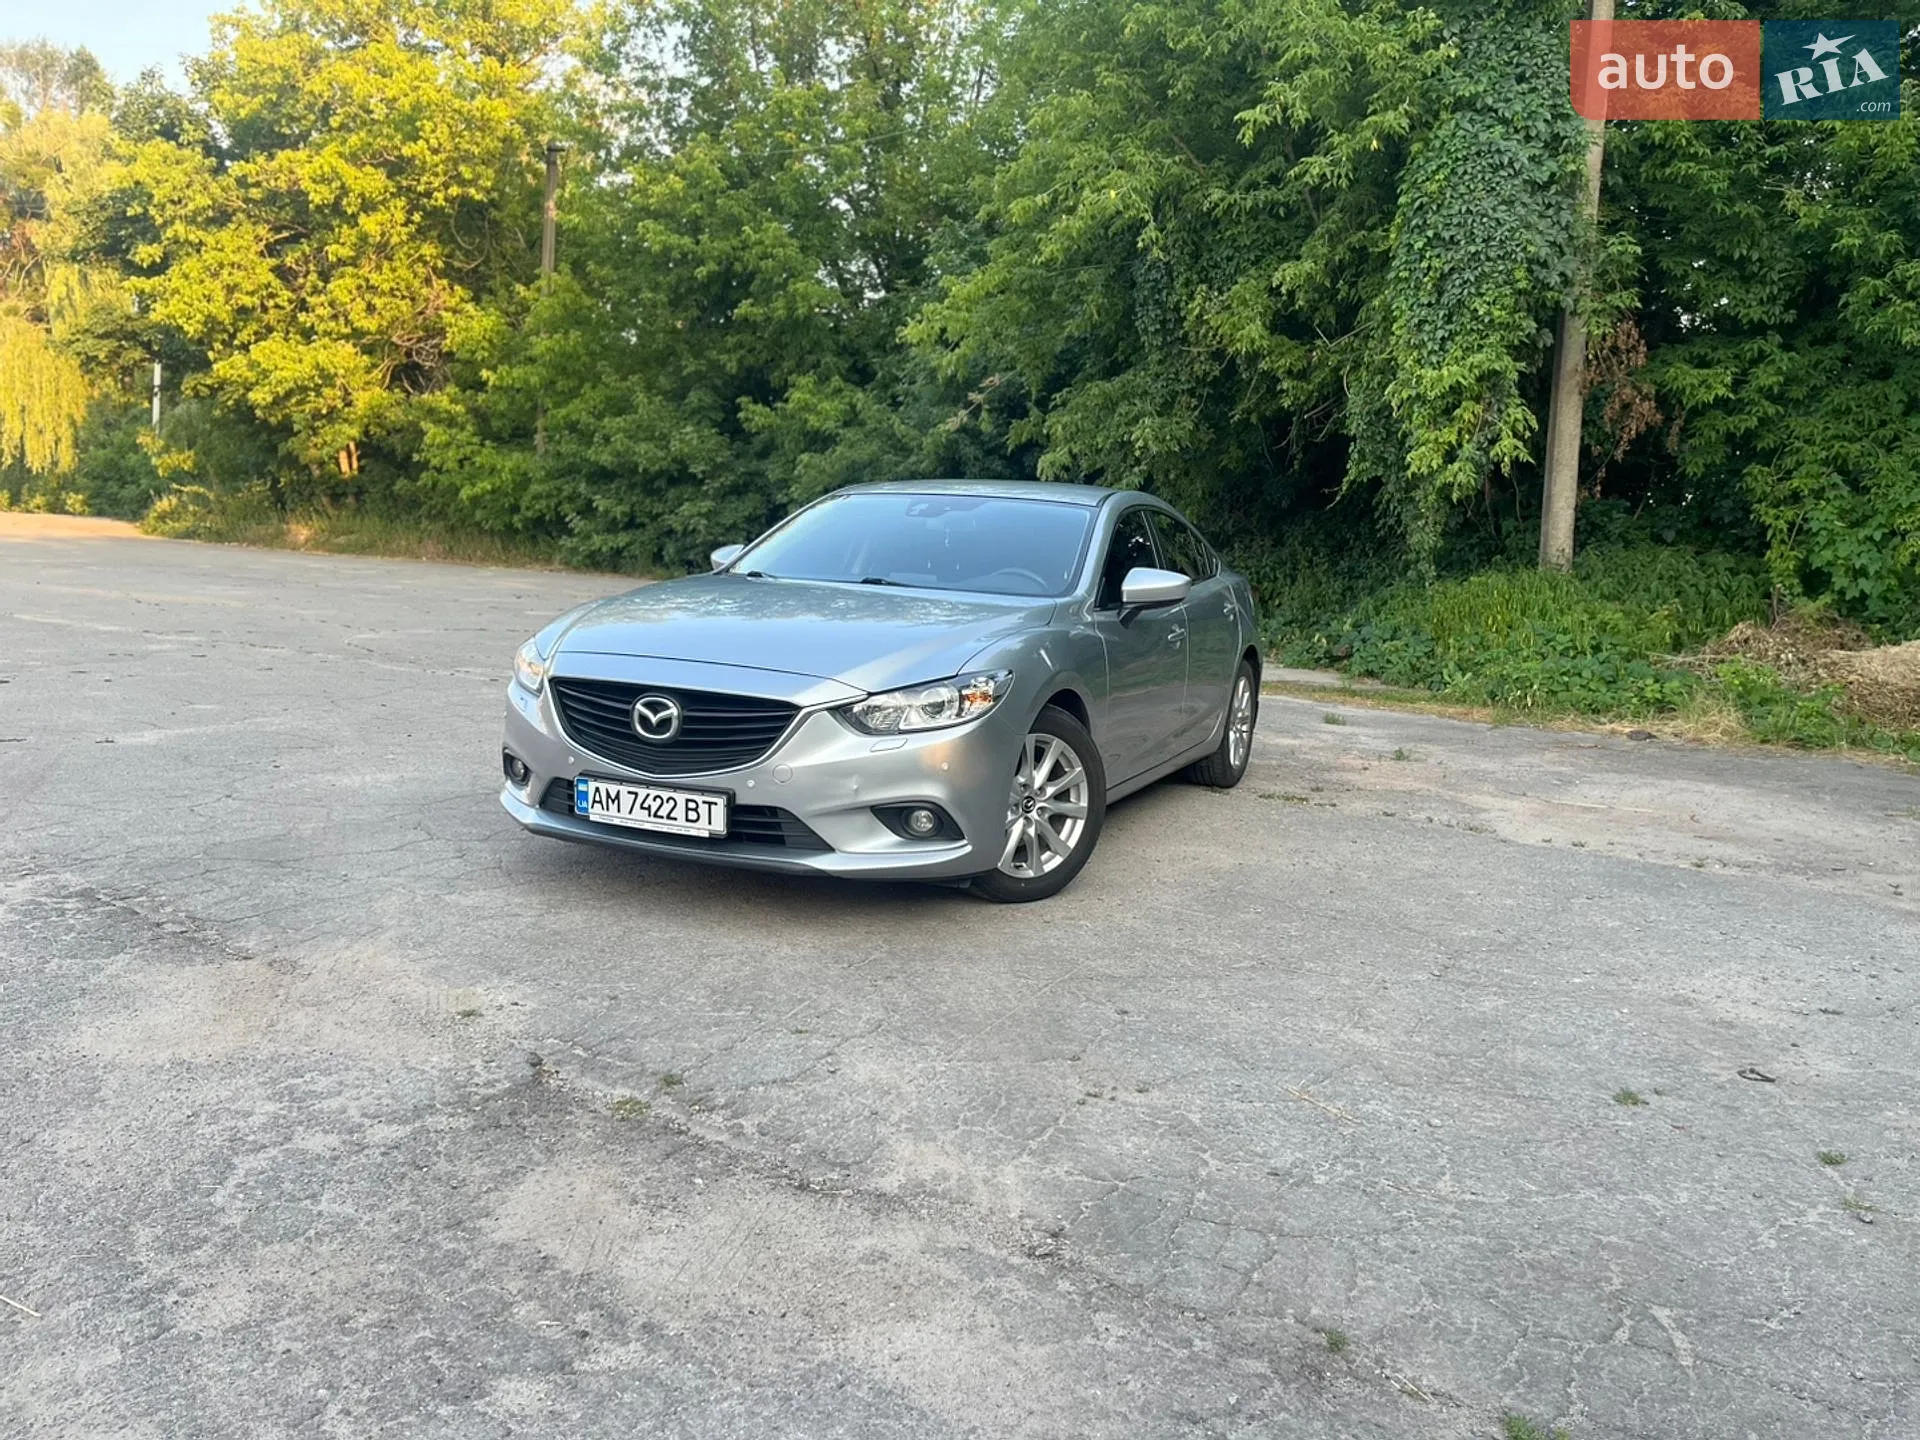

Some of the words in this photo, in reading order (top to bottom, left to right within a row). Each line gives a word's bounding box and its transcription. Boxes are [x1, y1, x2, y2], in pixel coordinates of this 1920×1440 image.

[577, 799, 588, 809] UA
[591, 786, 621, 813] AM
[627, 790, 678, 821] 7422
[685, 798, 718, 826] BT
